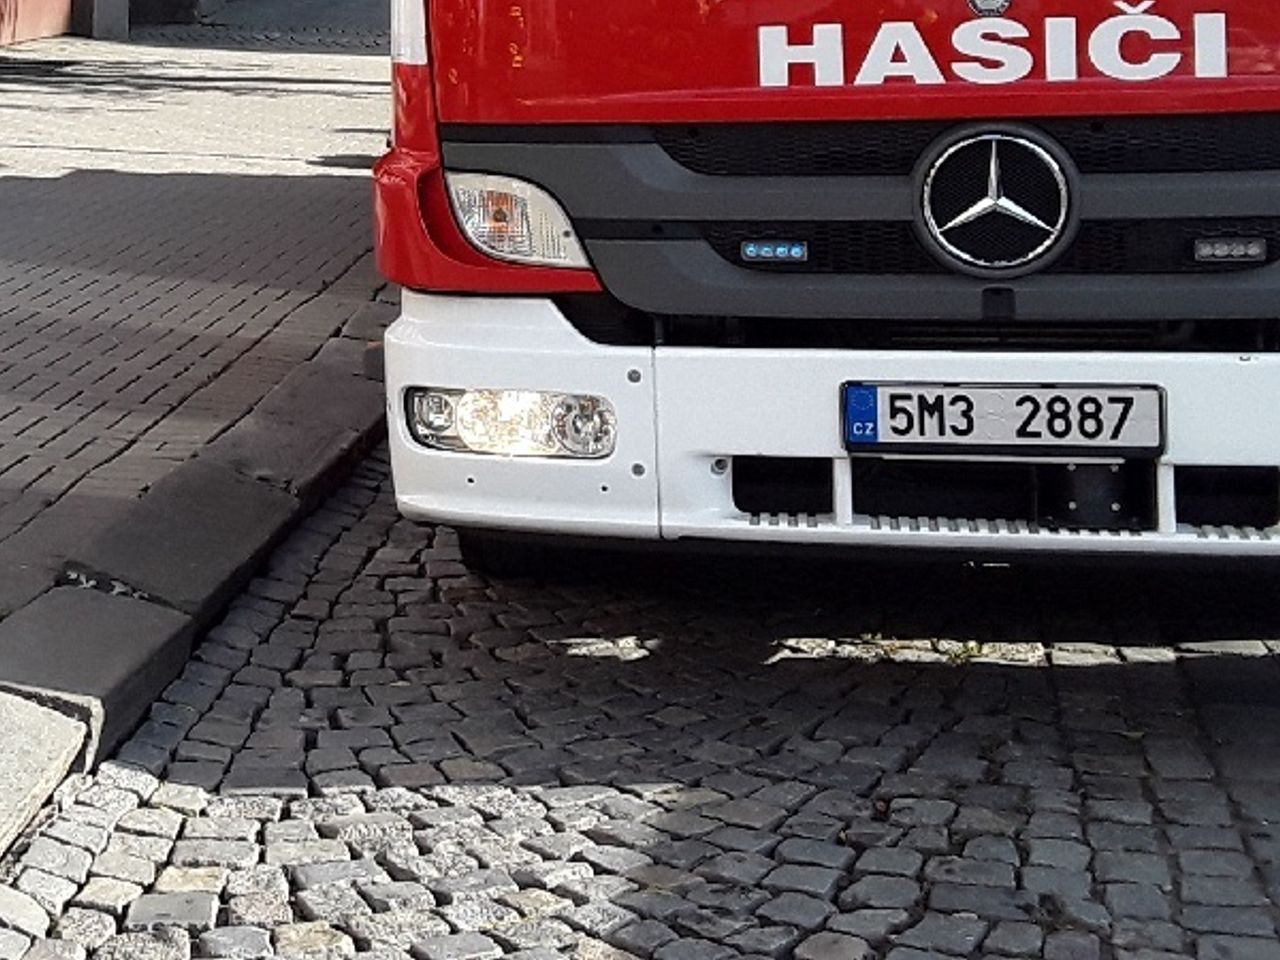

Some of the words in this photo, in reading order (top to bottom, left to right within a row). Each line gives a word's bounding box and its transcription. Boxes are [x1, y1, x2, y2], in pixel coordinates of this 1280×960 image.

[757, 0, 1228, 87] HASIČI
[852, 422, 875, 435] CZ
[888, 393, 975, 437] 5M3
[1014, 394, 1135, 440] 2887
